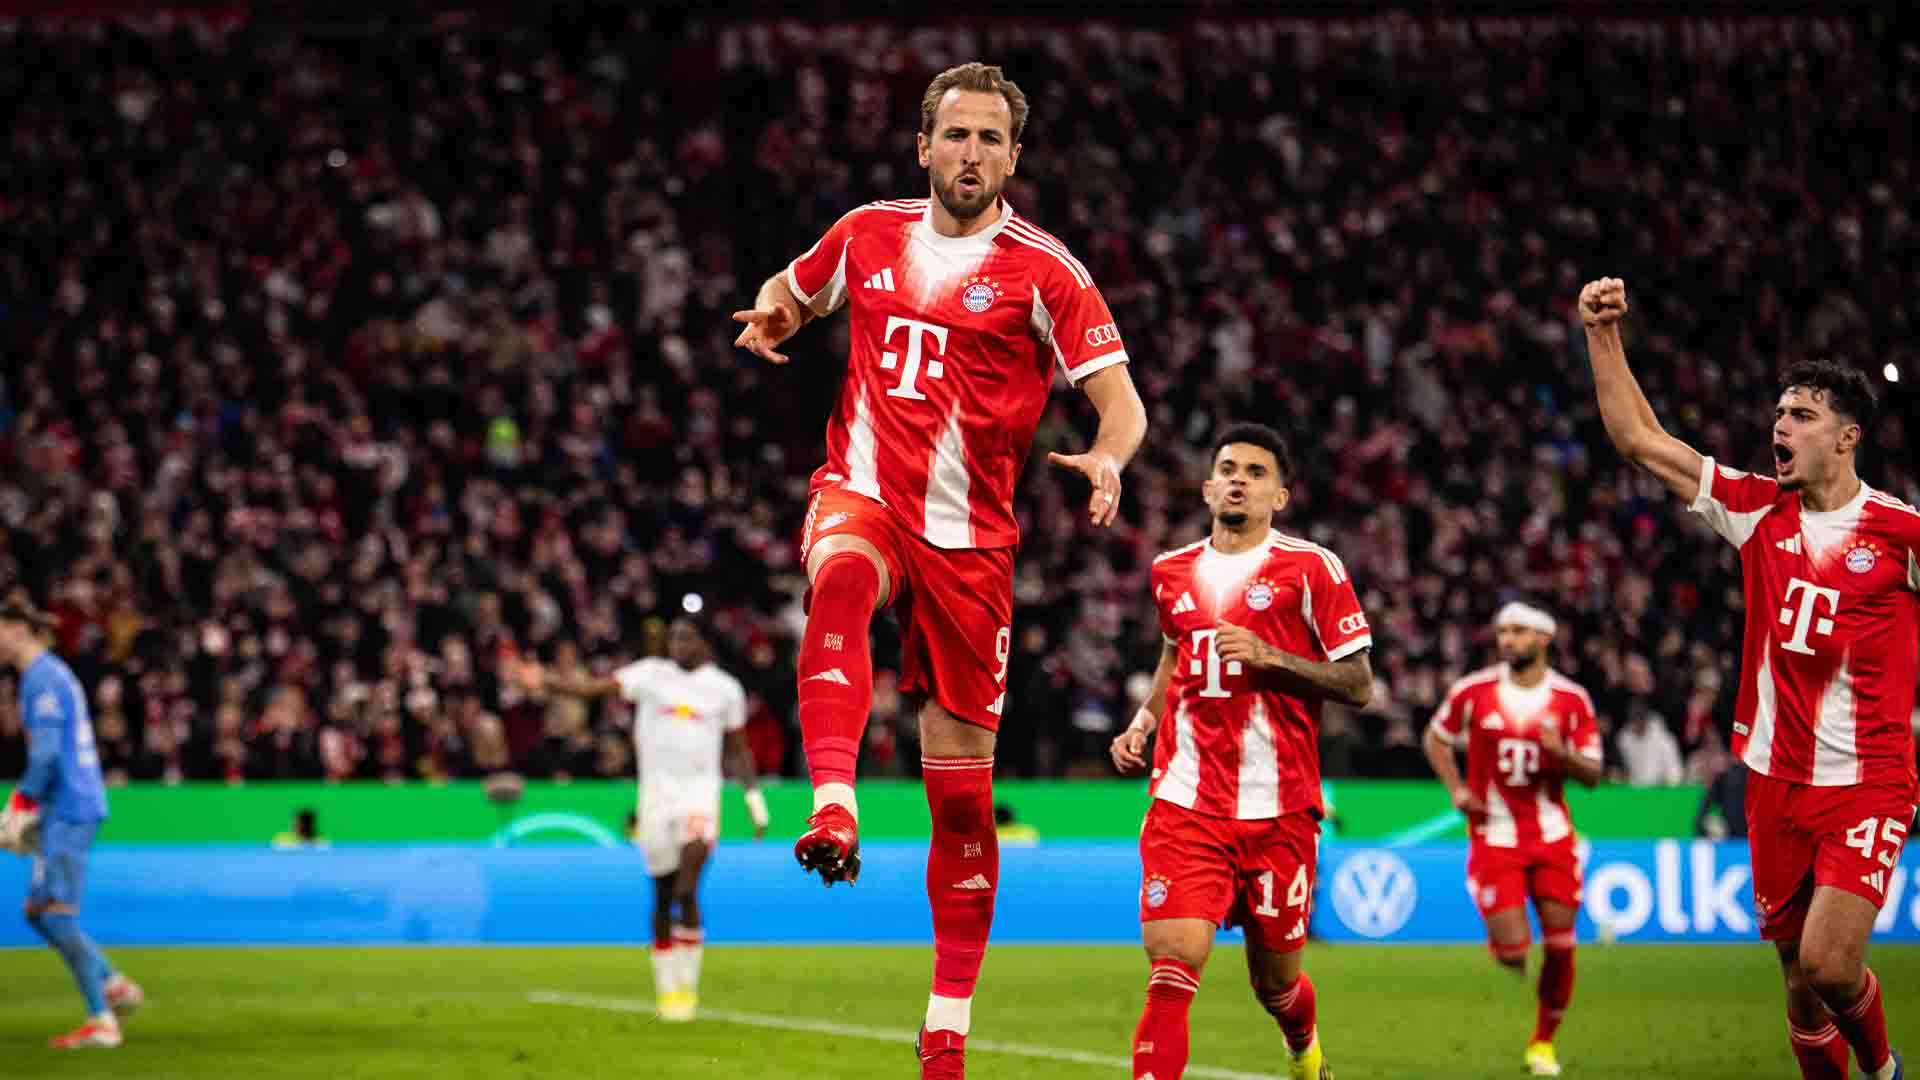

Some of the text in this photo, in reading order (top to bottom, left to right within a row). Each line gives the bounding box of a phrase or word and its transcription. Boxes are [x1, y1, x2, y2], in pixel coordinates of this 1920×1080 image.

[881, 316, 949, 400] T
[1780, 577, 1840, 656] T
[994, 627, 1009, 682] 9
[1191, 629, 1235, 698] T
[1498, 738, 1539, 786] T
[1846, 817, 1907, 868] 45
[1256, 864, 1308, 917] 14
